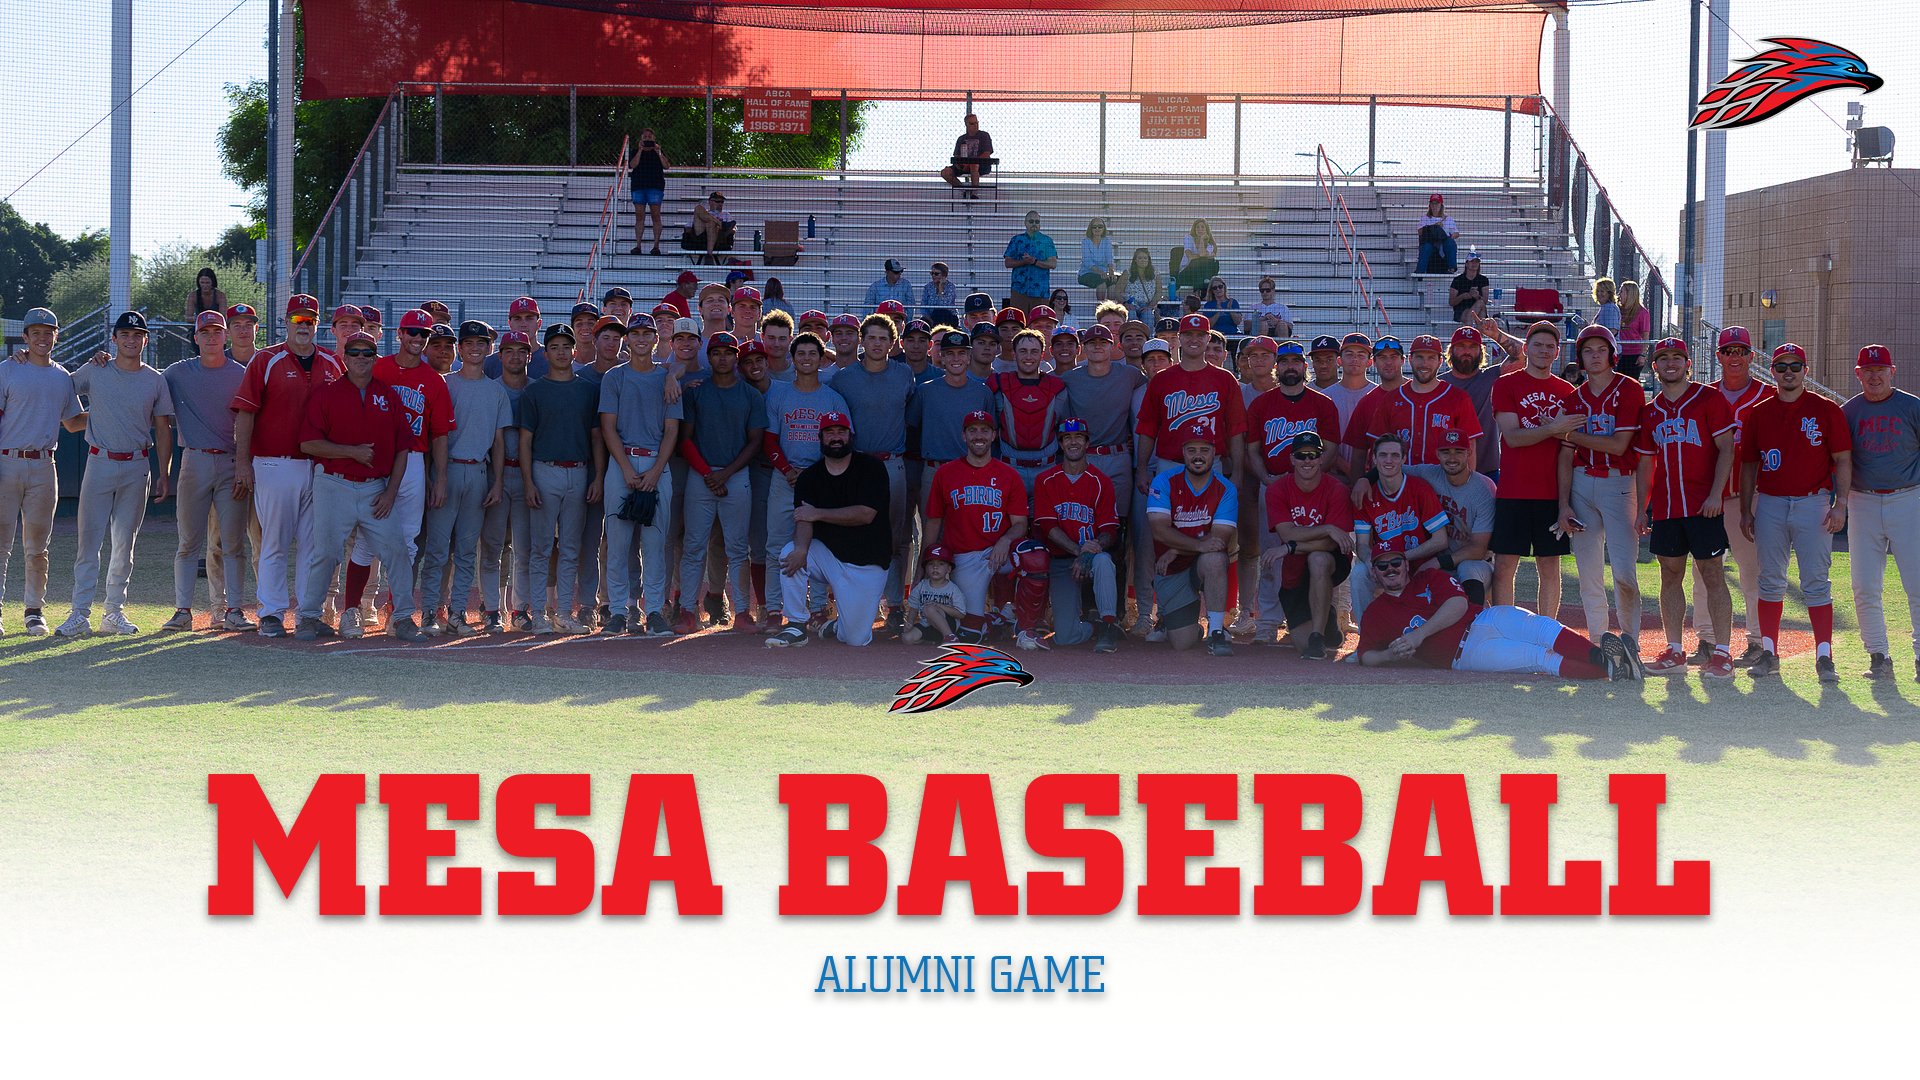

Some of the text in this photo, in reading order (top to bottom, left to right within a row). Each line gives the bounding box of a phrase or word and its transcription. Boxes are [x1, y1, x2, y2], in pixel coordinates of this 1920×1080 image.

[765, 90, 791, 98] ABCA
[1157, 96, 1190, 104] NJCAA
[785, 100, 810, 108] FAME
[748, 109, 808, 119] JIM BROCK
[1147, 115, 1200, 125] JIM FRYE
[750, 121, 805, 132] 1966-1971
[1165, 320, 1174, 329] B
[1189, 317, 1200, 327] C
[372, 394, 389, 411] MC
[1164, 390, 1220, 420] Mesa
[1520, 392, 1546, 408] MESA
[1431, 413, 1450, 429] MC
[1858, 416, 1902, 435] MCC
[1264, 416, 1317, 445] Mesa
[1651, 417, 1702, 447] MESA
[1800, 416, 1823, 446] MCC
[990, 477, 997, 486] C
[950, 486, 1003, 509] T-BIRDS
[983, 511, 1003, 533] 17
